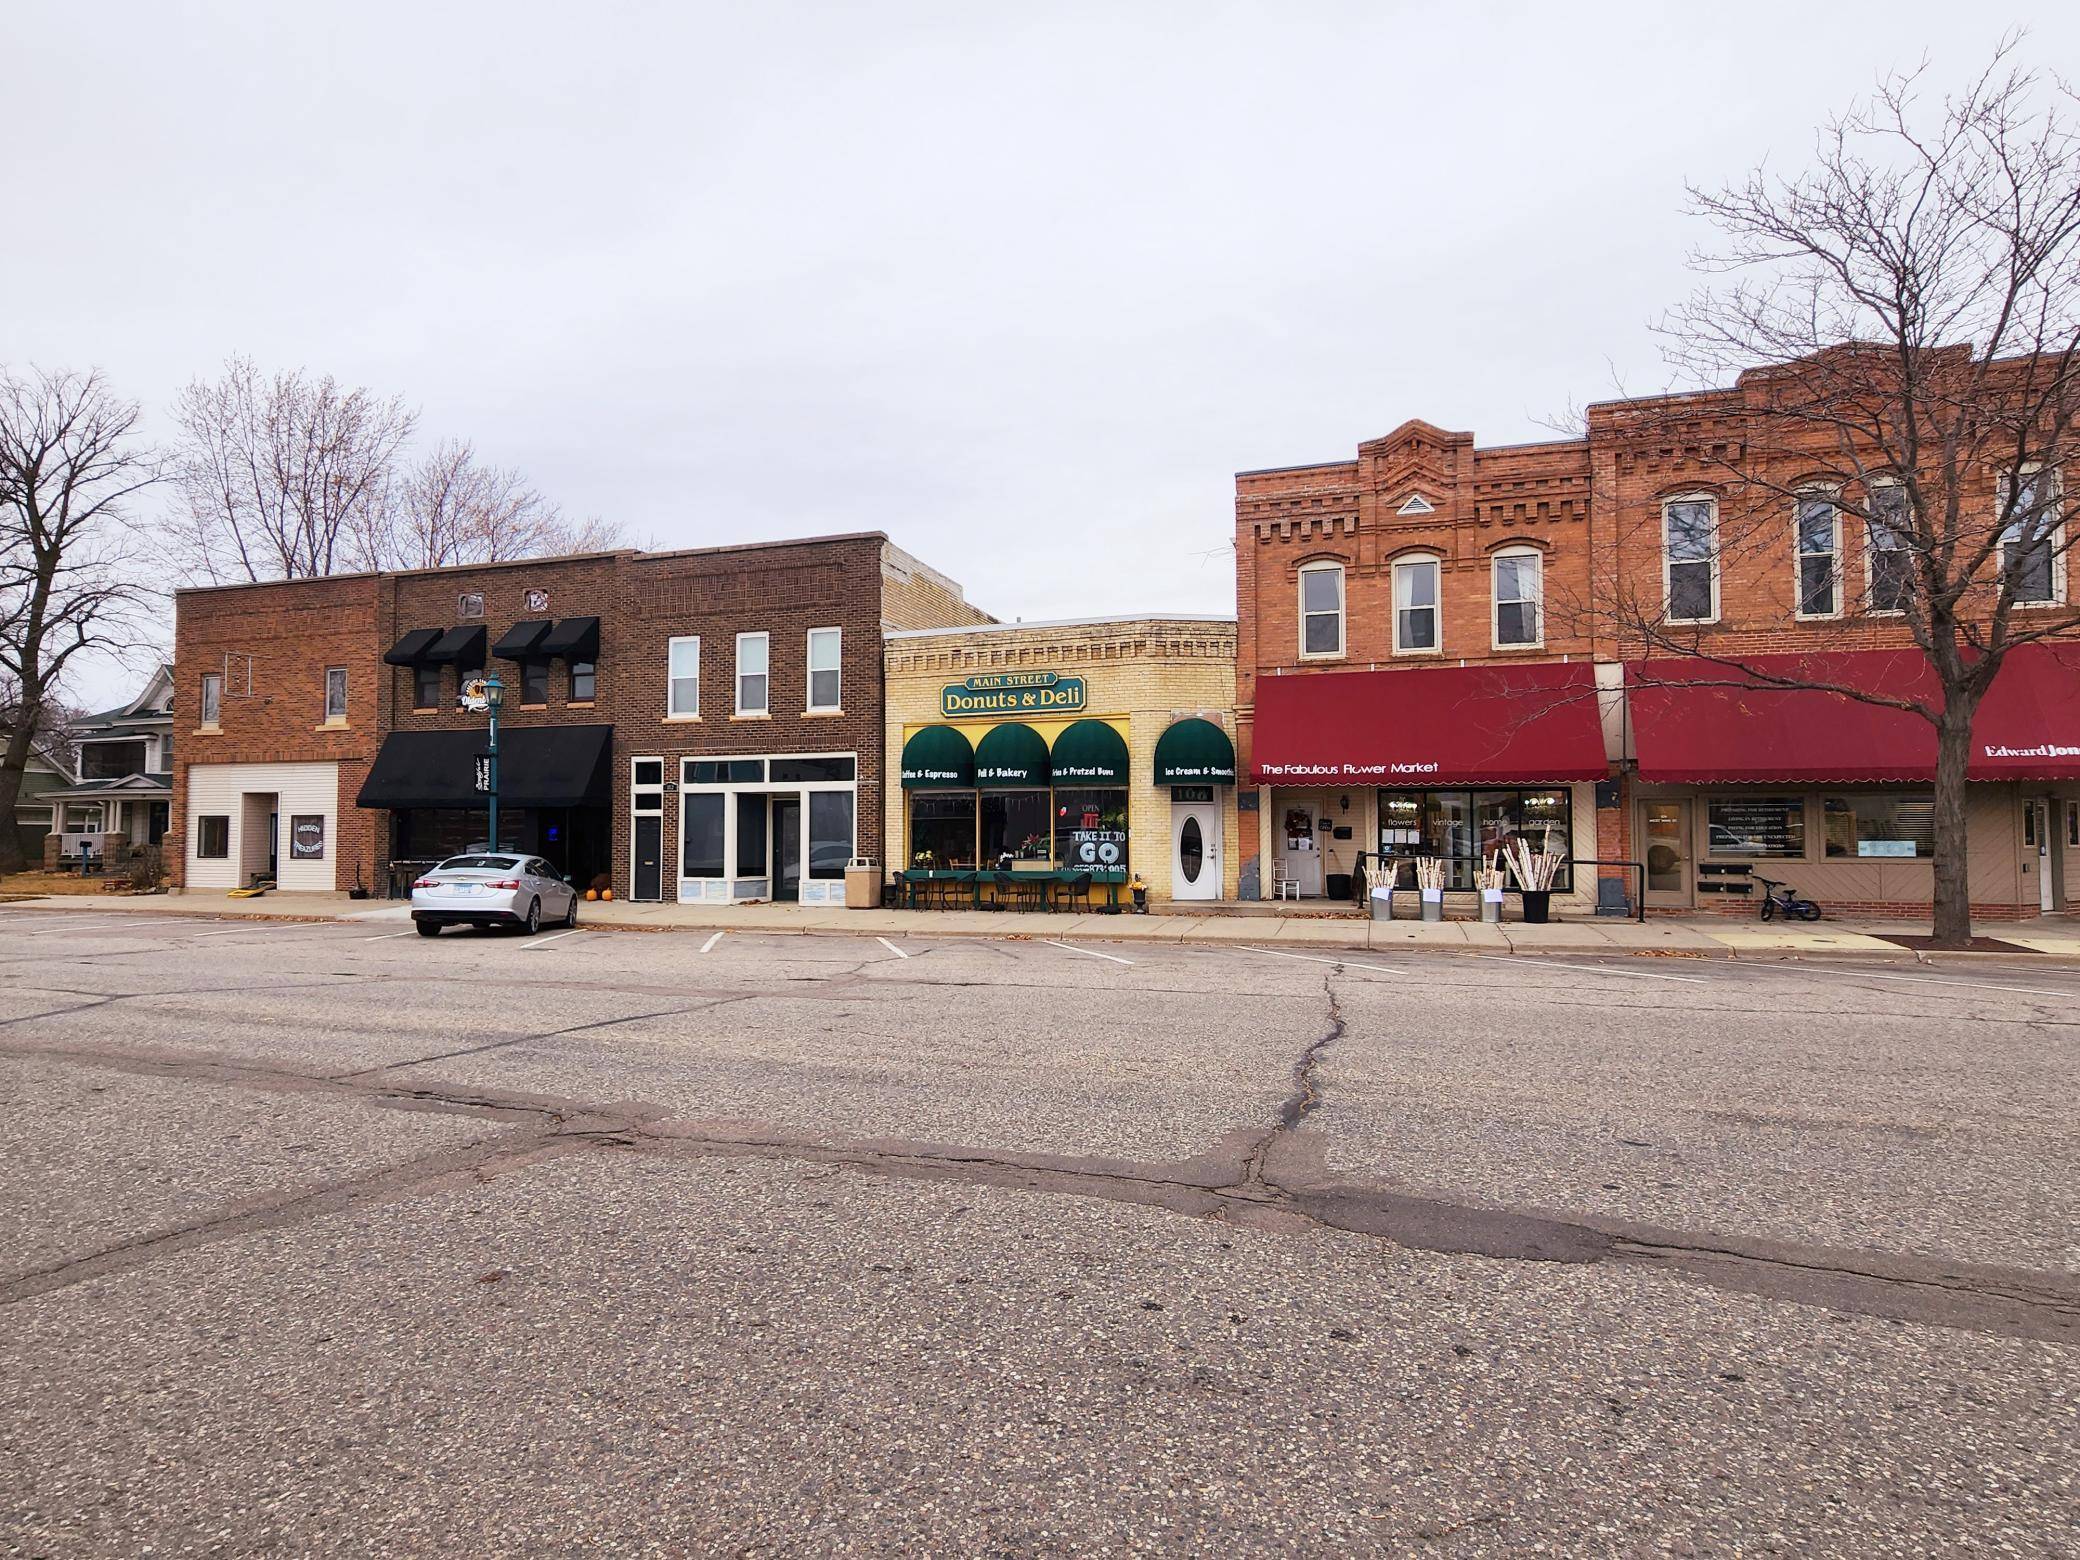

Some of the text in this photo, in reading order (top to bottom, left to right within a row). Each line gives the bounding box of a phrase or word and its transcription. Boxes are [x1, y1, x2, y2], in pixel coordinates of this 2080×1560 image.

[973, 674, 1049, 687] MAIN STREET
[946, 687, 1080, 710] Donuts & Deli
[1984, 744, 2080, 756] Edward Jon
[988, 768, 995, 777] &
[996, 768, 1027, 778] Bakery
[1070, 767, 1095, 776] Pretzel
[1176, 767, 1201, 776] Cream
[1203, 767, 1211, 775] &
[1262, 764, 1283, 774] The
[1284, 764, 1338, 775] Fabulous
[1391, 762, 1438, 774] Market
[917, 770, 923, 778] &
[925, 770, 958, 780] Espresso
[1433, 819, 1464, 828] vintage
[1529, 819, 1561, 827] garden
[1073, 831, 1125, 841] TAKE IT TO
[1080, 842, 1120, 864] GO
